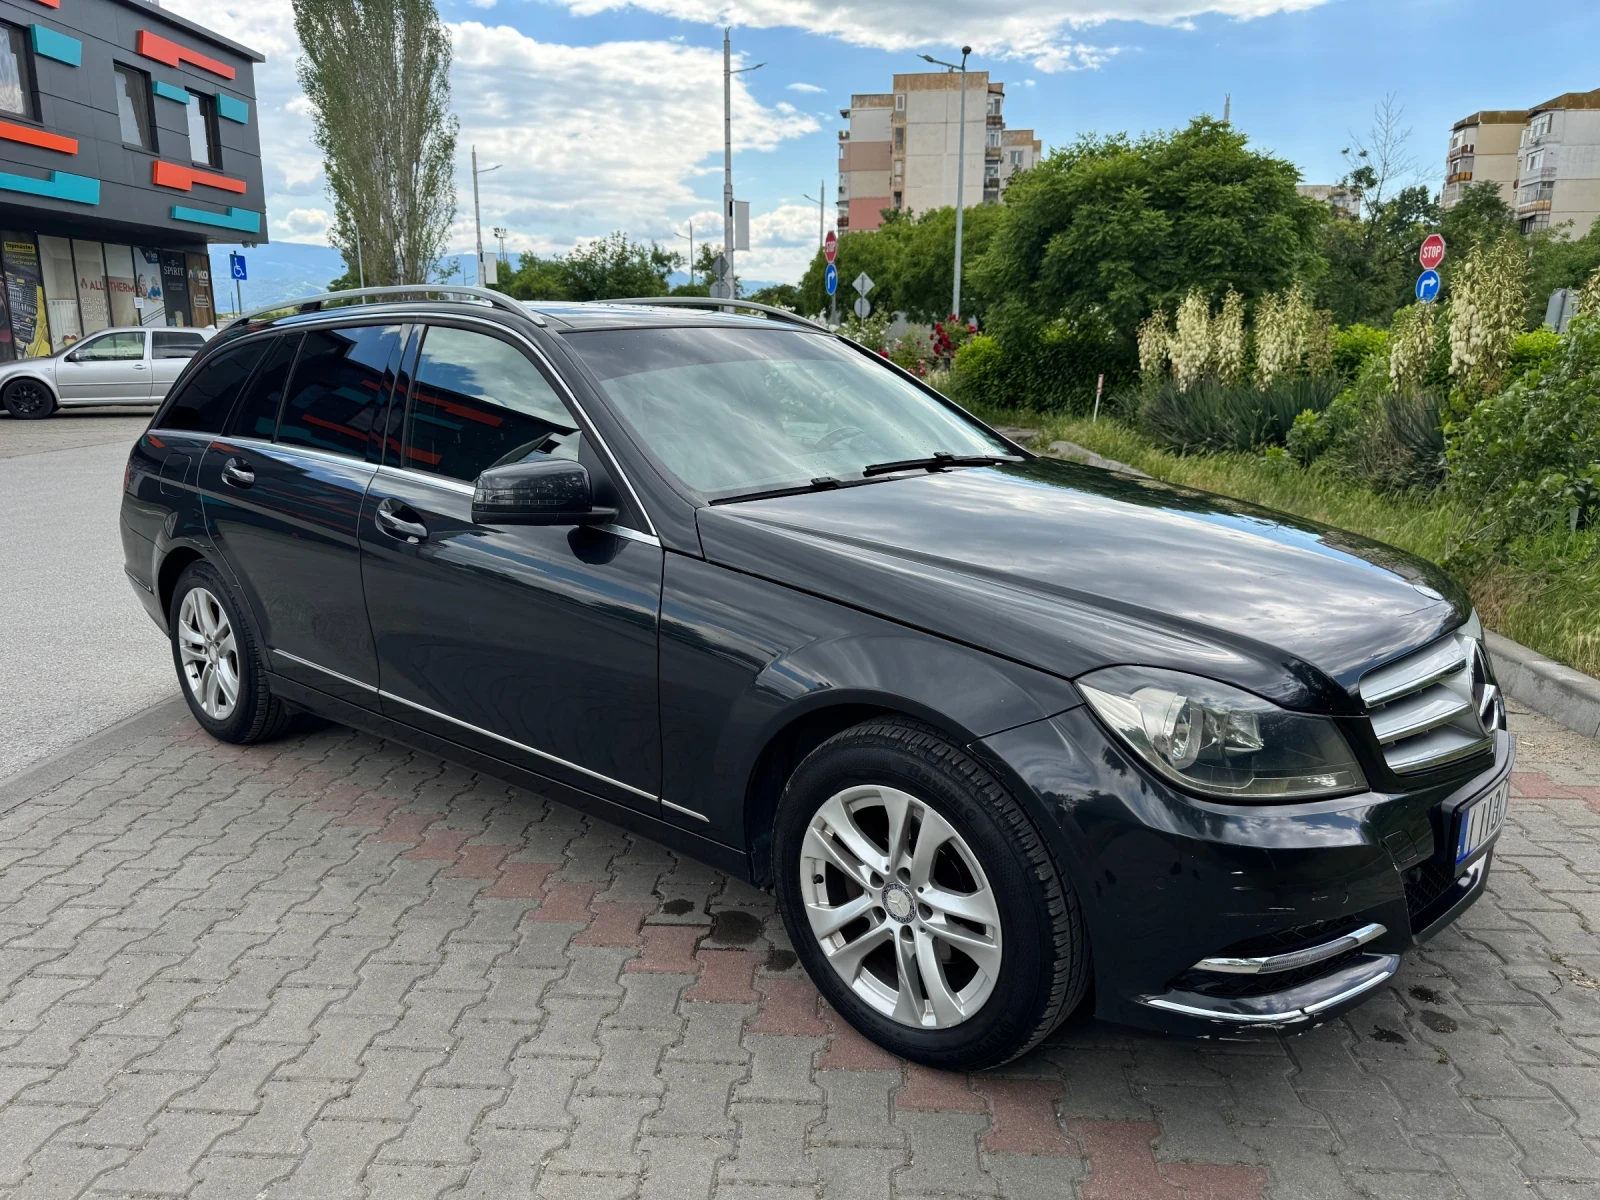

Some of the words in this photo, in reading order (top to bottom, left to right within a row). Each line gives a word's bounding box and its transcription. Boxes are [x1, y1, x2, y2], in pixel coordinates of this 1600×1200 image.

[6, 242, 33, 250] topmaster
[1422, 246, 1442, 259] STOP
[163, 265, 184, 276] SPIRIT
[109, 281, 135, 293] THERM
